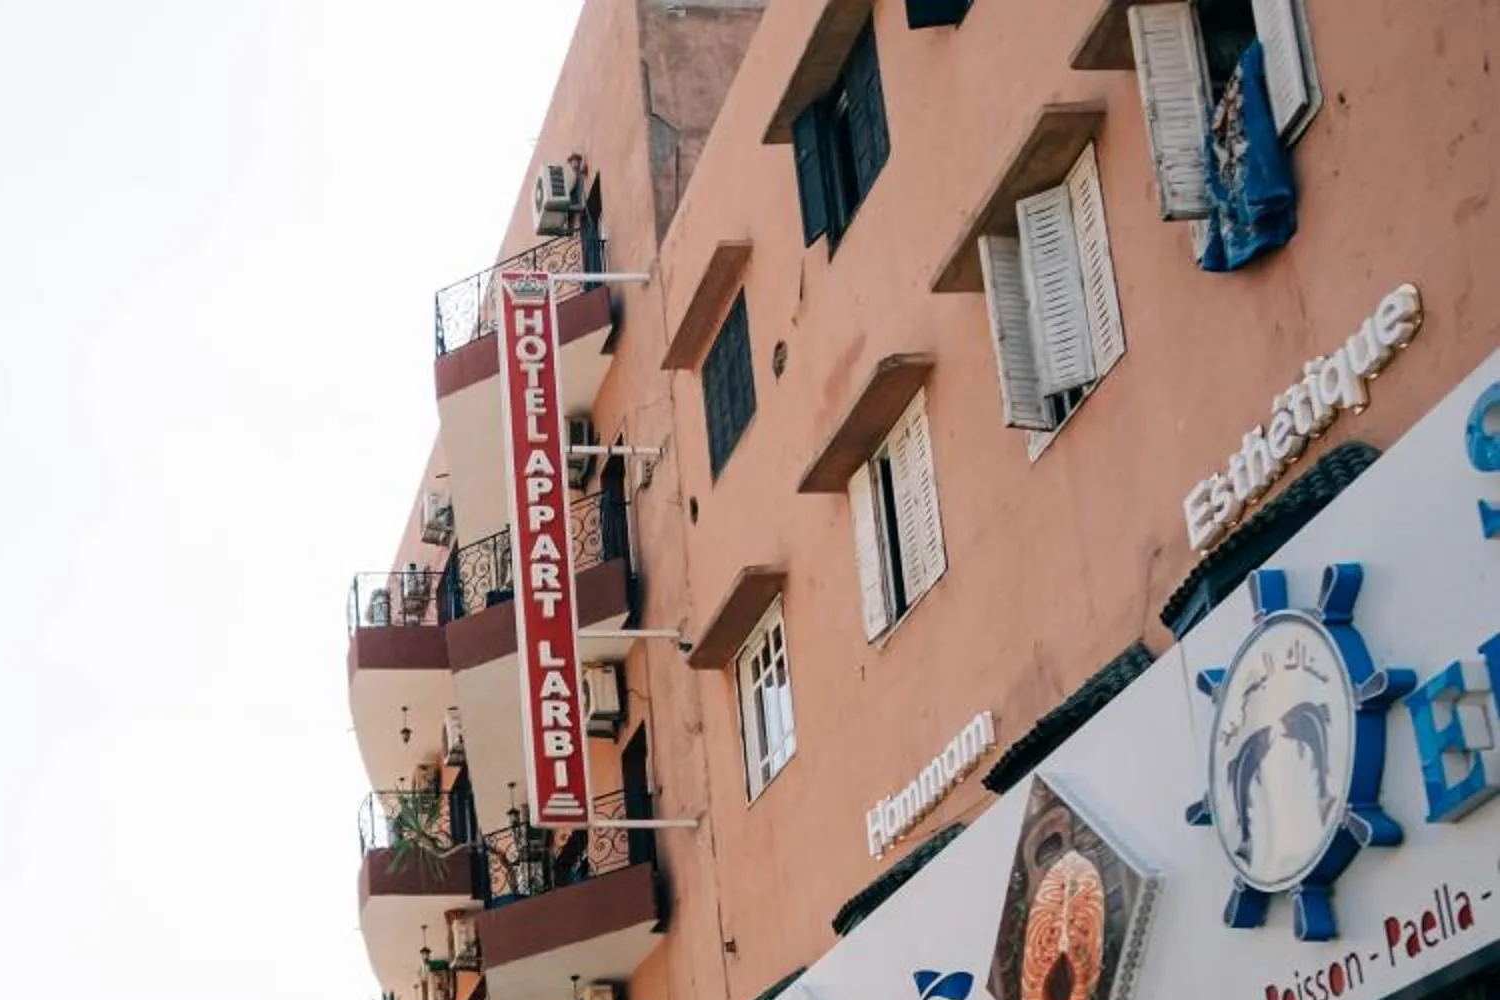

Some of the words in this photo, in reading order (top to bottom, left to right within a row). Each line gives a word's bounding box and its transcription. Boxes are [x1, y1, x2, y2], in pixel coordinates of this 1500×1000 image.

[515, 307, 549, 443] HOTEL
[524, 448, 562, 619] APPART
[537, 640, 574, 788] LARBI
[866, 710, 996, 858] Hammam
[1384, 884, 1474, 967] Paella
